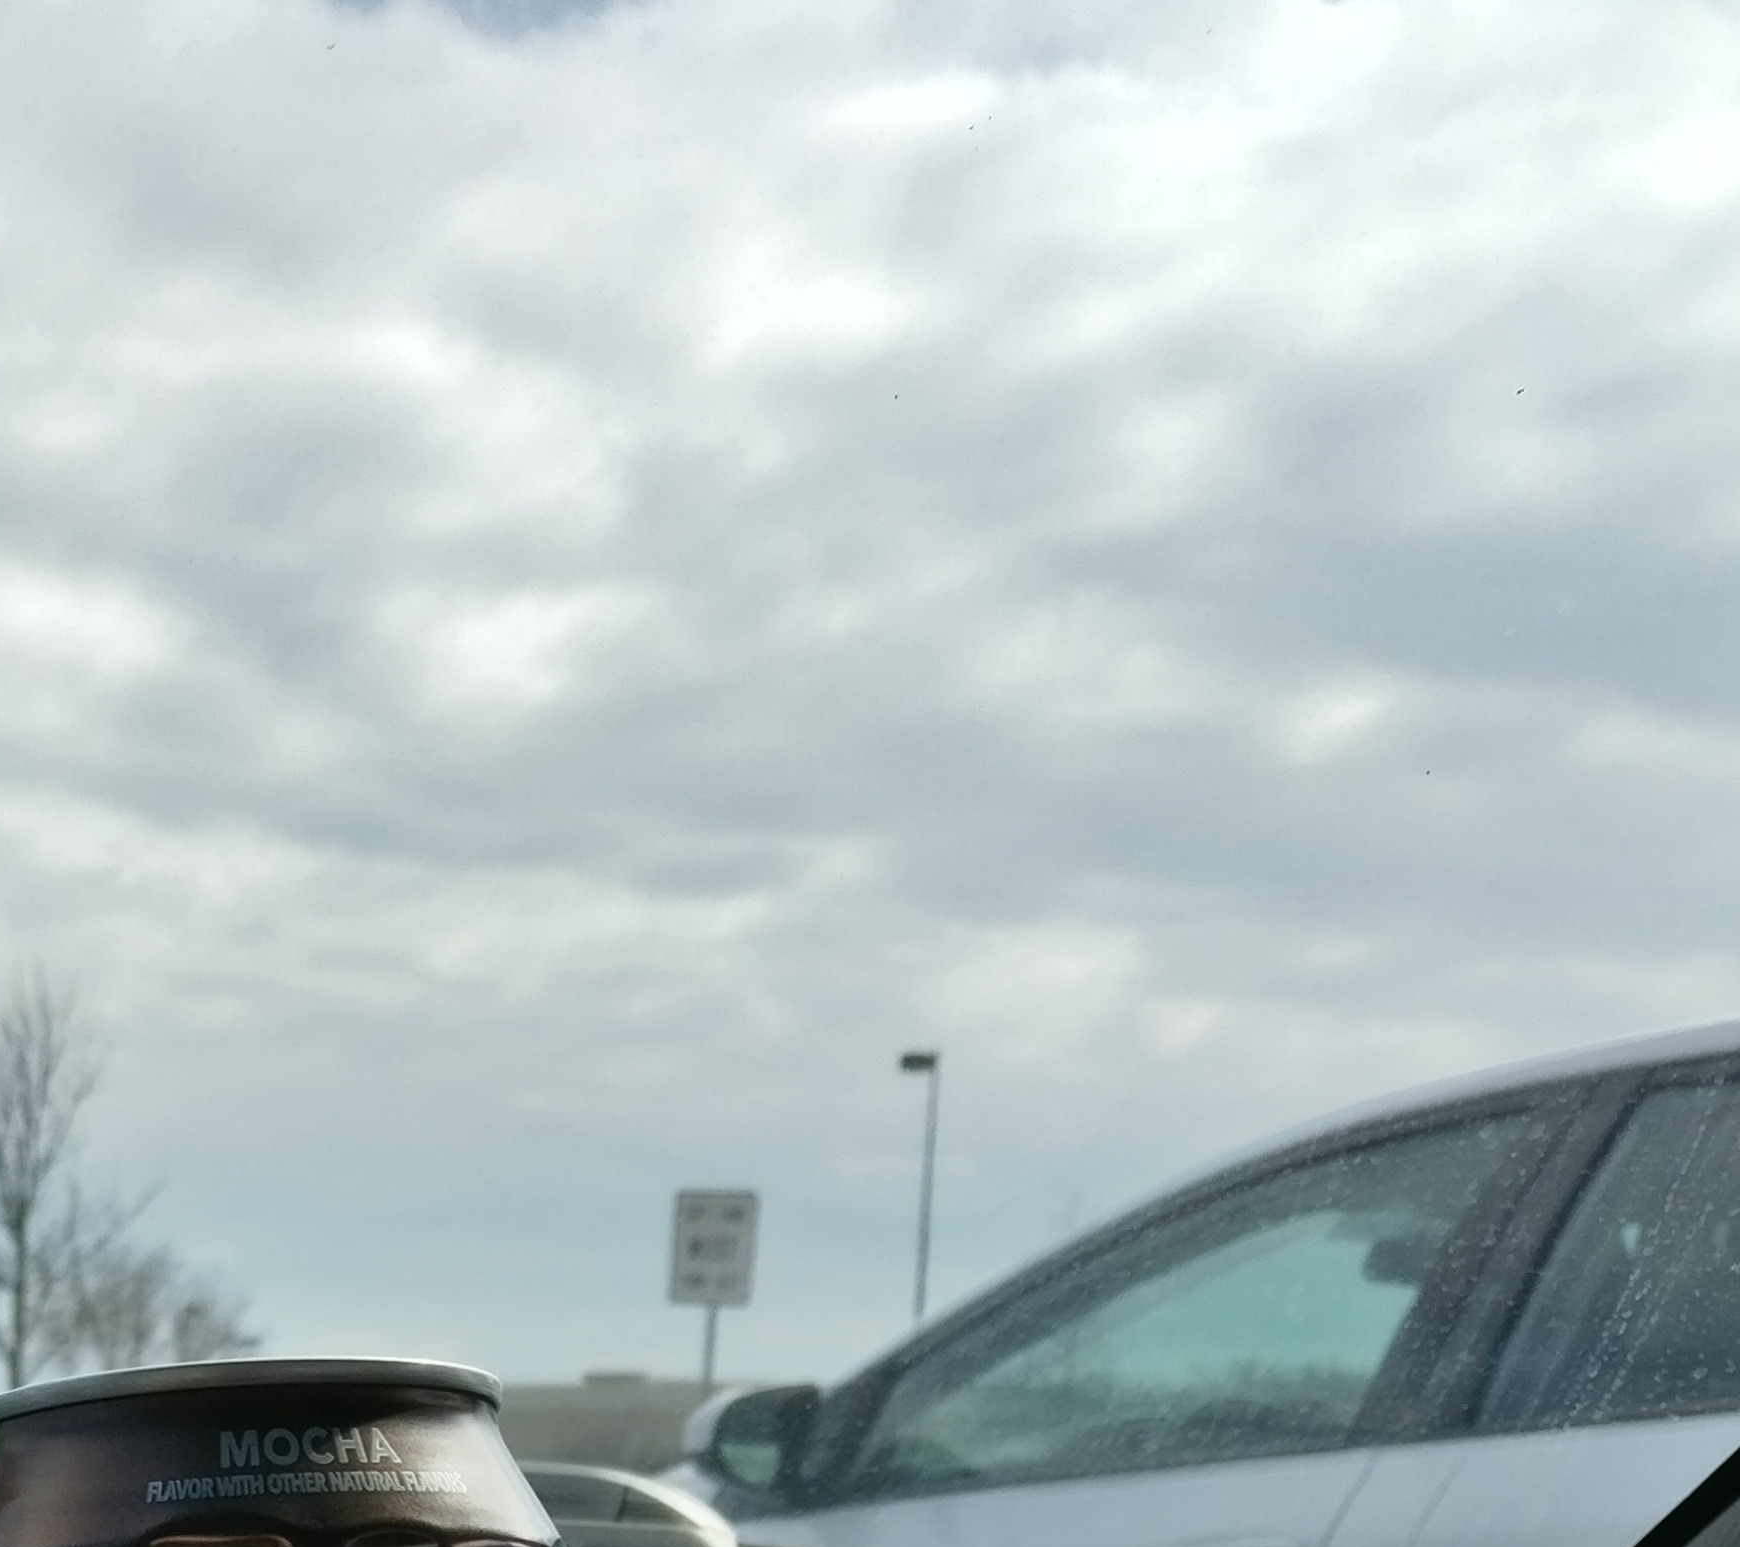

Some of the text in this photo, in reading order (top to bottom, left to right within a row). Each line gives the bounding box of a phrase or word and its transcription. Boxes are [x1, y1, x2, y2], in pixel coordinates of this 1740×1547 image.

[220, 1427, 402, 1468] MOCHA
[145, 1478, 215, 1503] FLAVOR
[216, 1474, 263, 1498] WITH
[267, 1472, 326, 1496] OTHER
[327, 1471, 403, 1494] NATURAL
